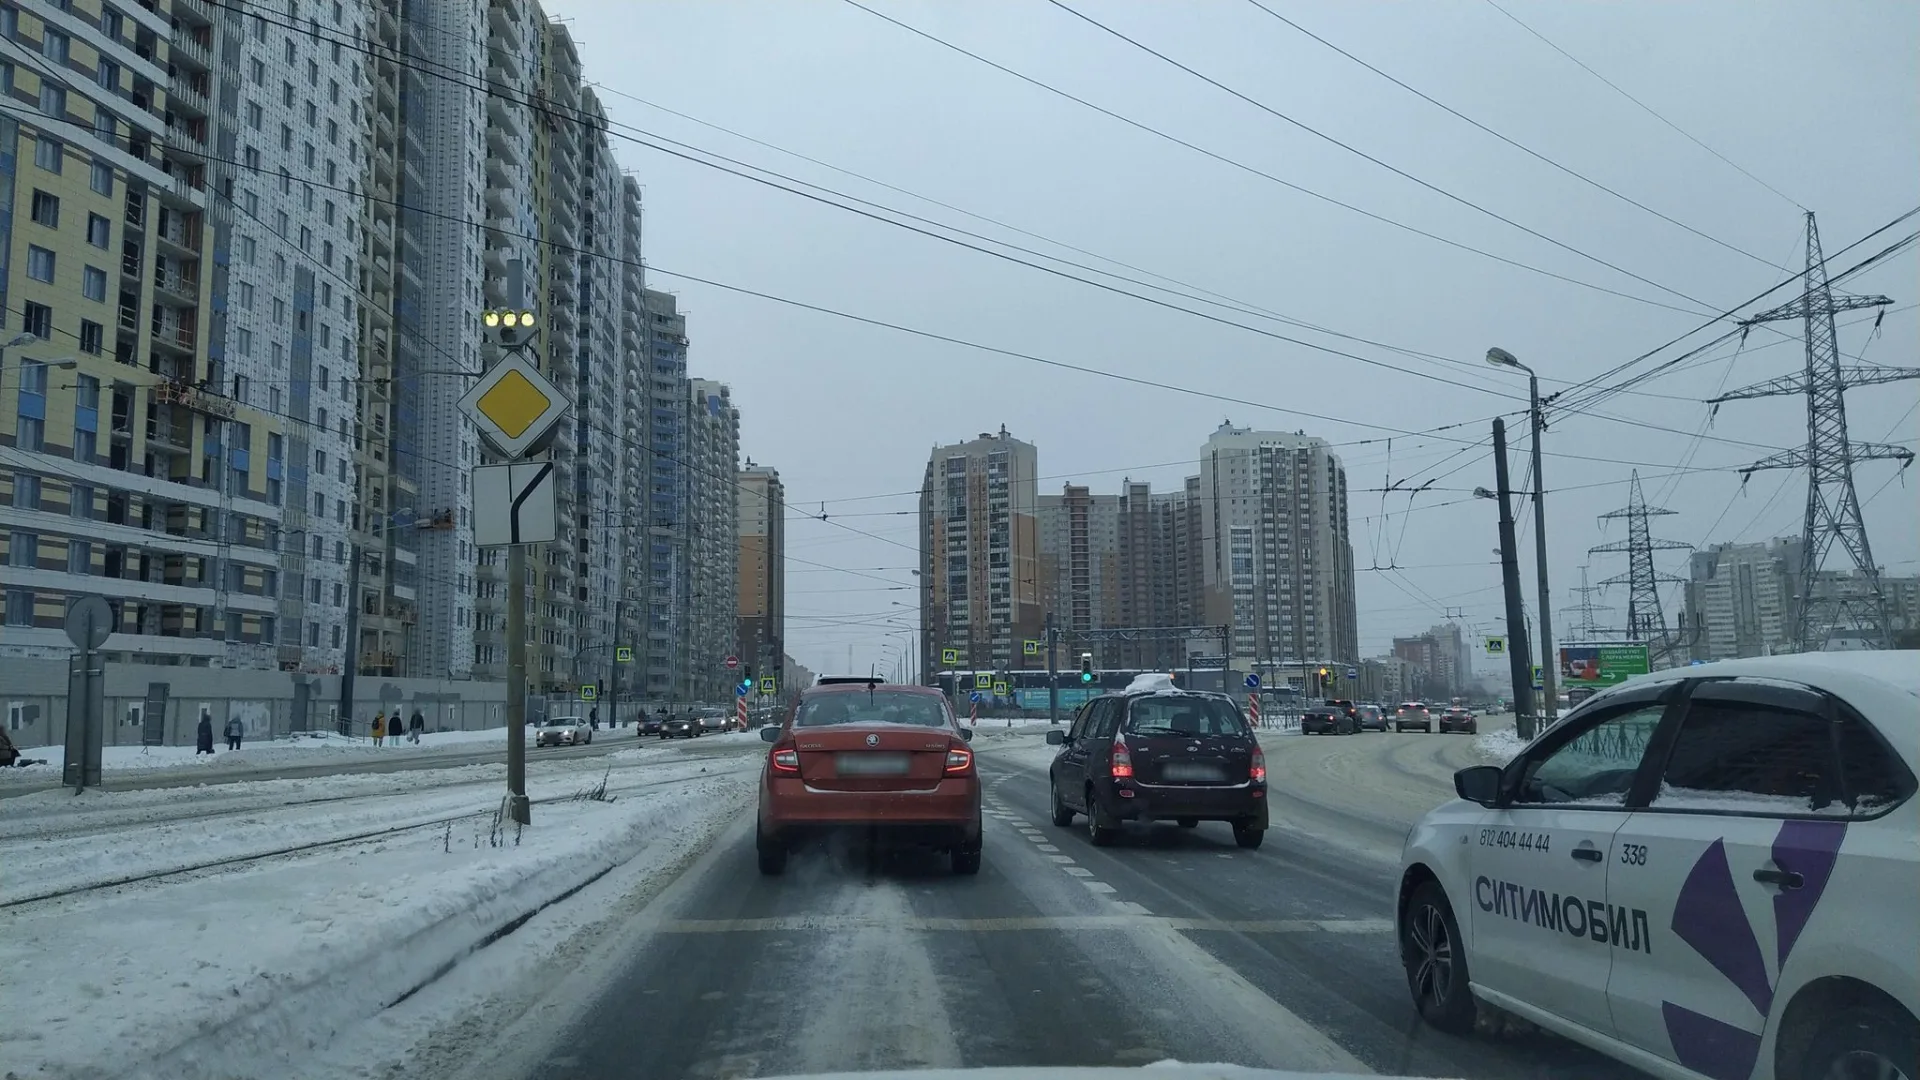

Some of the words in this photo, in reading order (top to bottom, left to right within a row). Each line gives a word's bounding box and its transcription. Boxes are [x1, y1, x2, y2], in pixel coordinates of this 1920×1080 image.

[1480, 829, 1494, 847] 812
[1497, 831, 1516, 849] 404
[1519, 833, 1532, 851] 44
[1535, 834, 1550, 853] 44
[1621, 843, 1648, 866] 338
[1476, 875, 1652, 955] СИТИМОБИЛ
